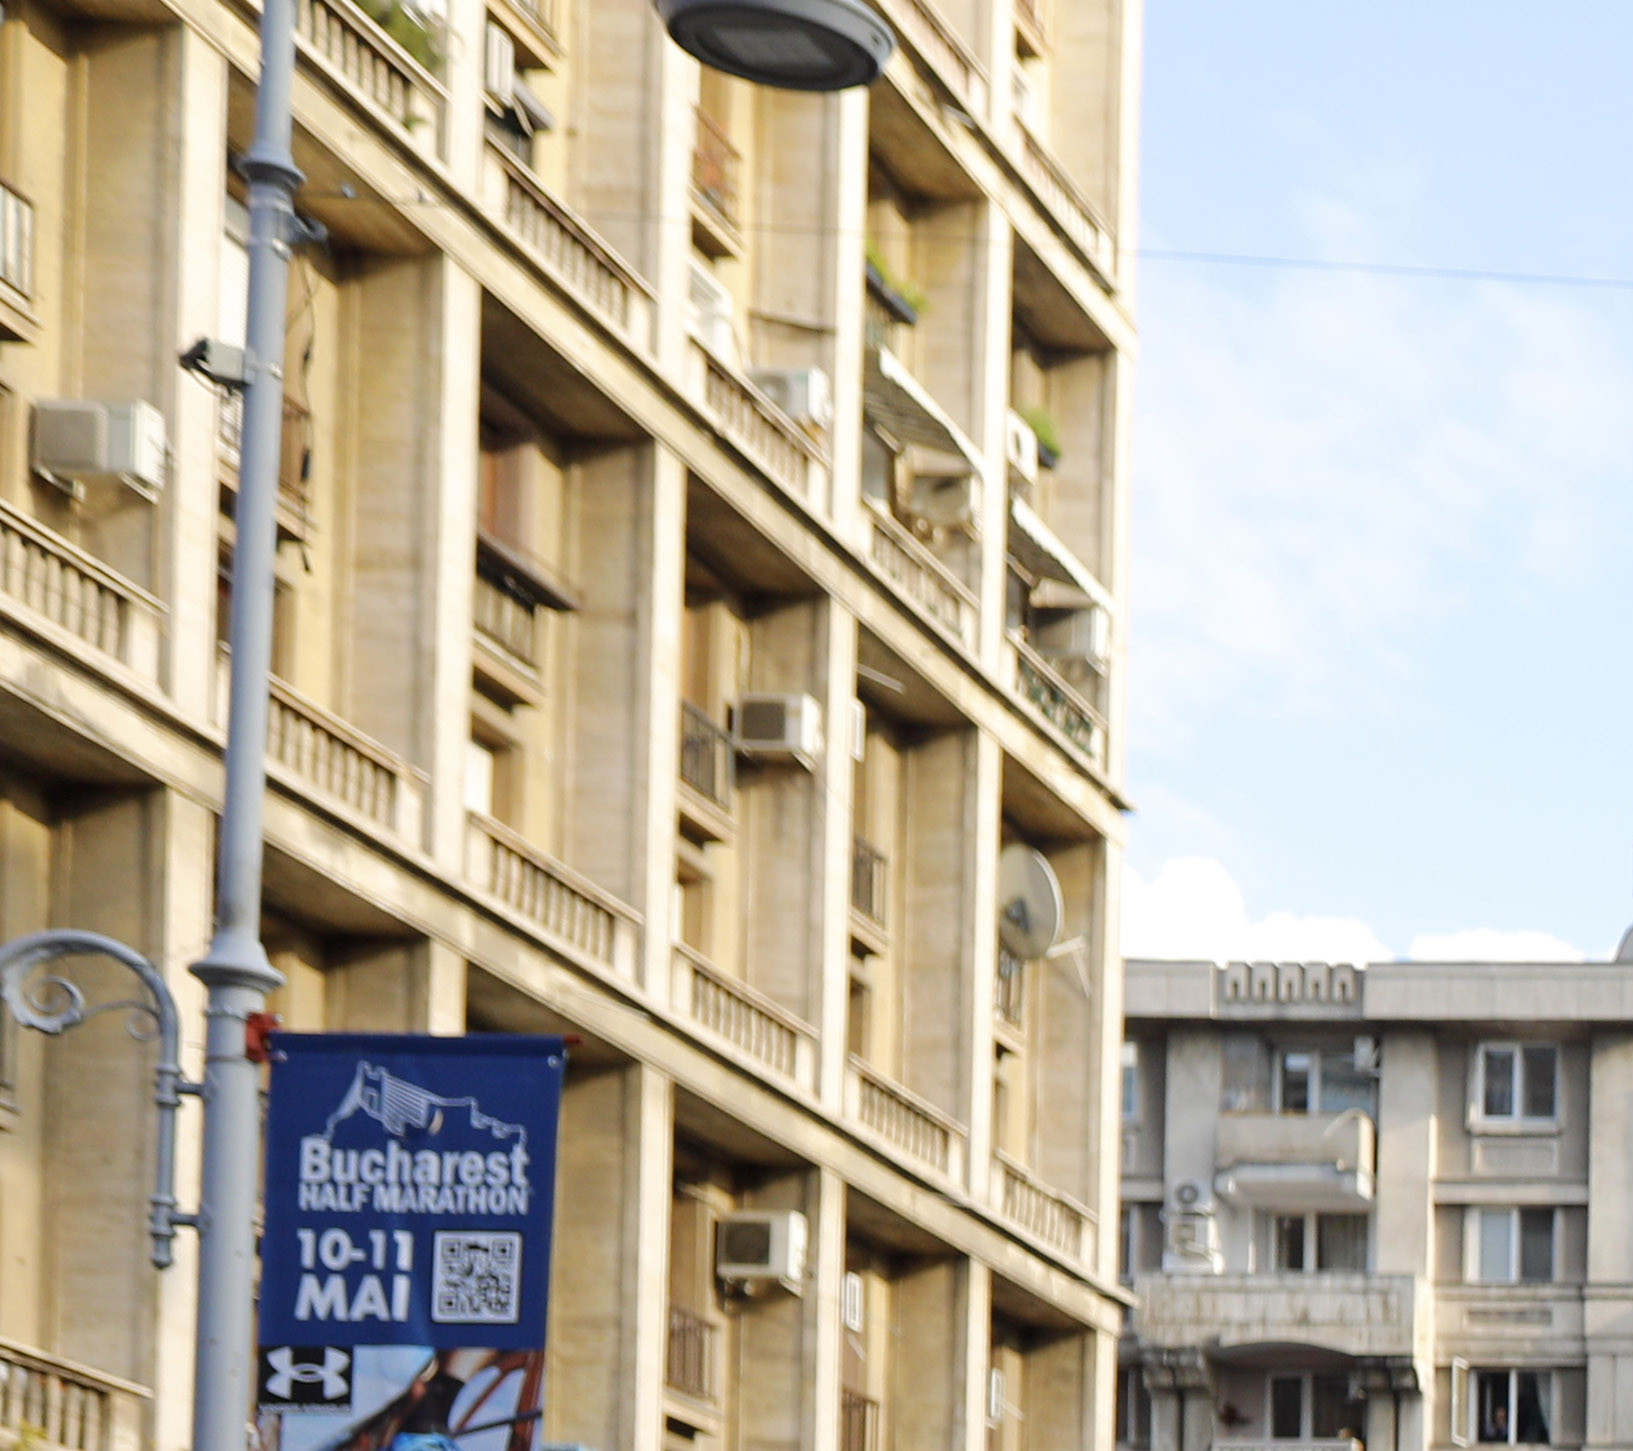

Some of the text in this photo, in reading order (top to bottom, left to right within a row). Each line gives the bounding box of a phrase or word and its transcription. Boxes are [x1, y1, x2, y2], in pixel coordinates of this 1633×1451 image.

[301, 1136, 530, 1187] Bucharest
[299, 1183, 528, 1215] HALF MARATHON
[297, 1227, 414, 1272] 10-11
[294, 1274, 411, 1322] MAI
